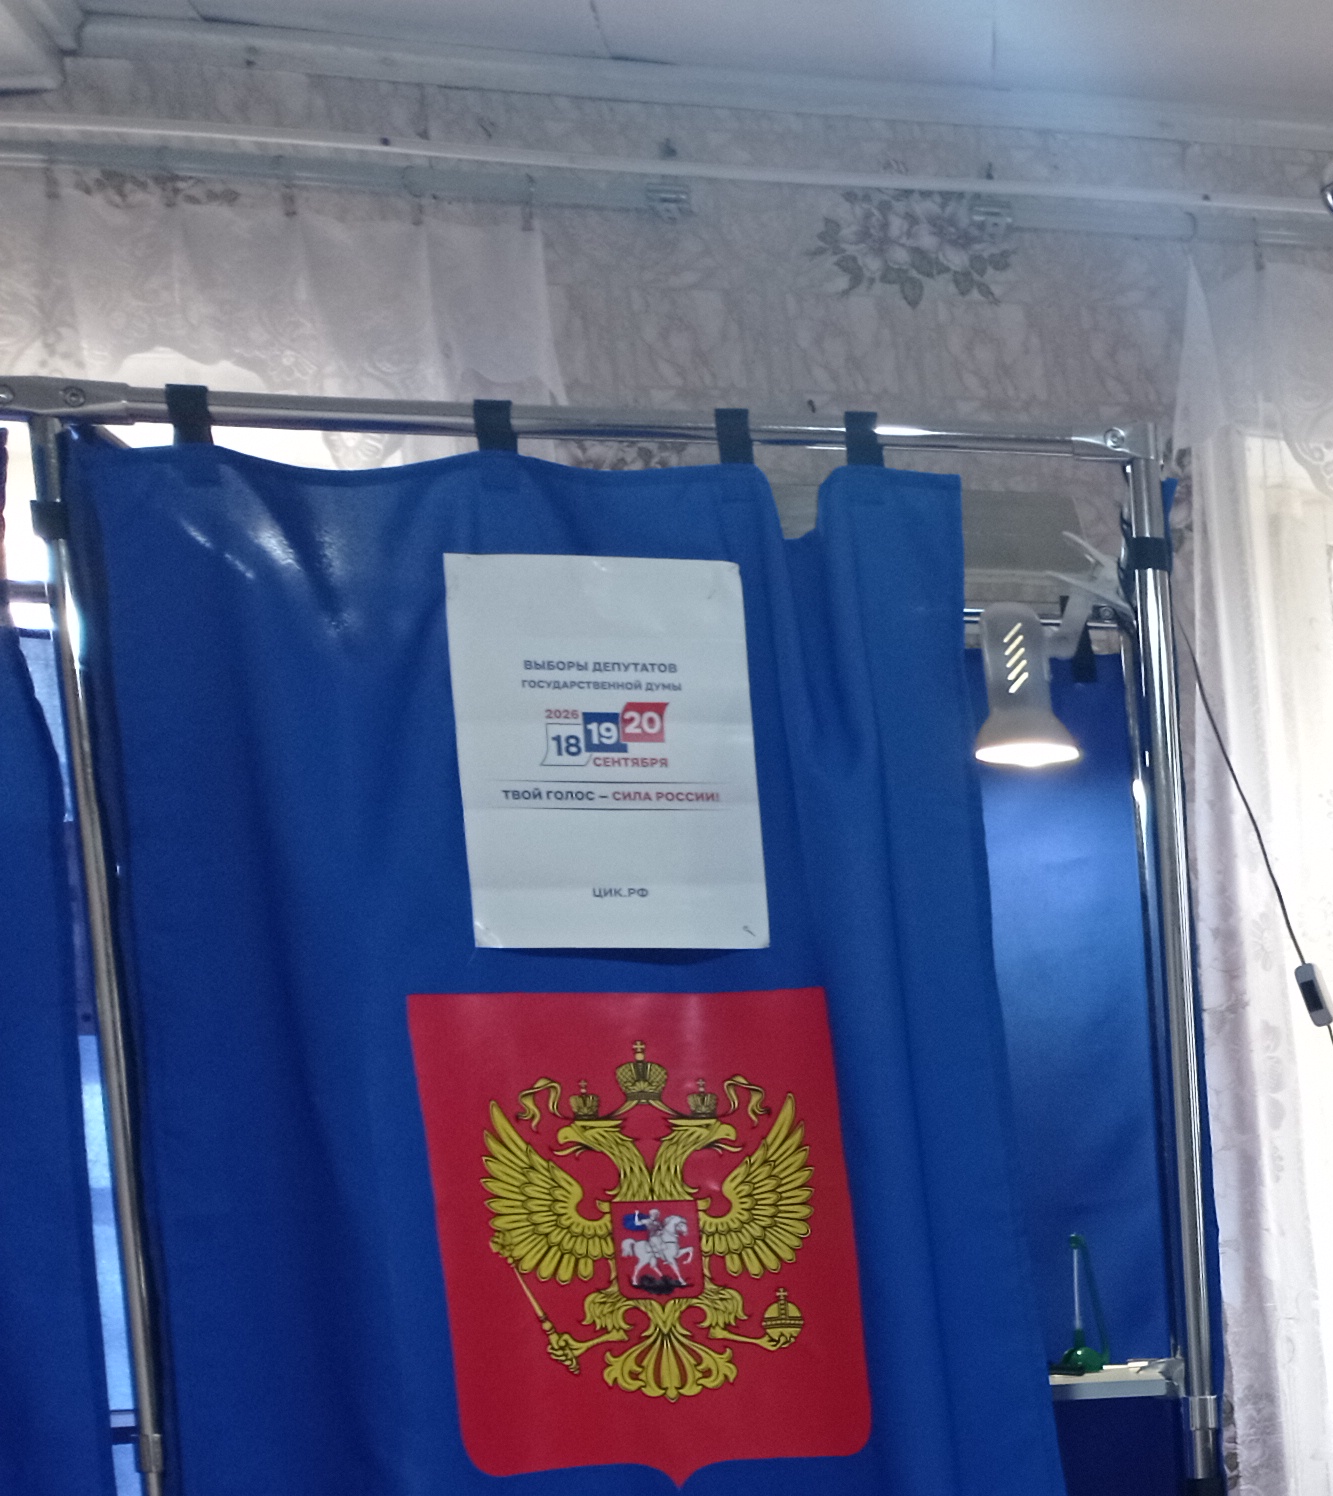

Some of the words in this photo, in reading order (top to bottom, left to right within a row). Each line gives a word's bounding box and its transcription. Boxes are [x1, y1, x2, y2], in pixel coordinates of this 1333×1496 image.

[523, 660, 589, 671] ВЫБОРЫ
[592, 661, 678, 674] ДЕПУТАТОВ
[521, 679, 642, 691] ГОСУДАРСТВЕННОЙ
[645, 682, 682, 692] ДУМЫ
[545, 709, 579, 719] 2026
[623, 711, 662, 734] 20
[586, 722, 618, 745] 19
[551, 734, 582, 757] 18
[593, 757, 668, 768] СЕНТЯБРЯ
[502, 788, 543, 801] ТВОЙ
[546, 790, 595, 801] ГОЛОС
[612, 791, 652, 802] СИЛА
[657, 791, 720, 803] РОССИИ!
[592, 887, 649, 898] ЦИК.РФ
